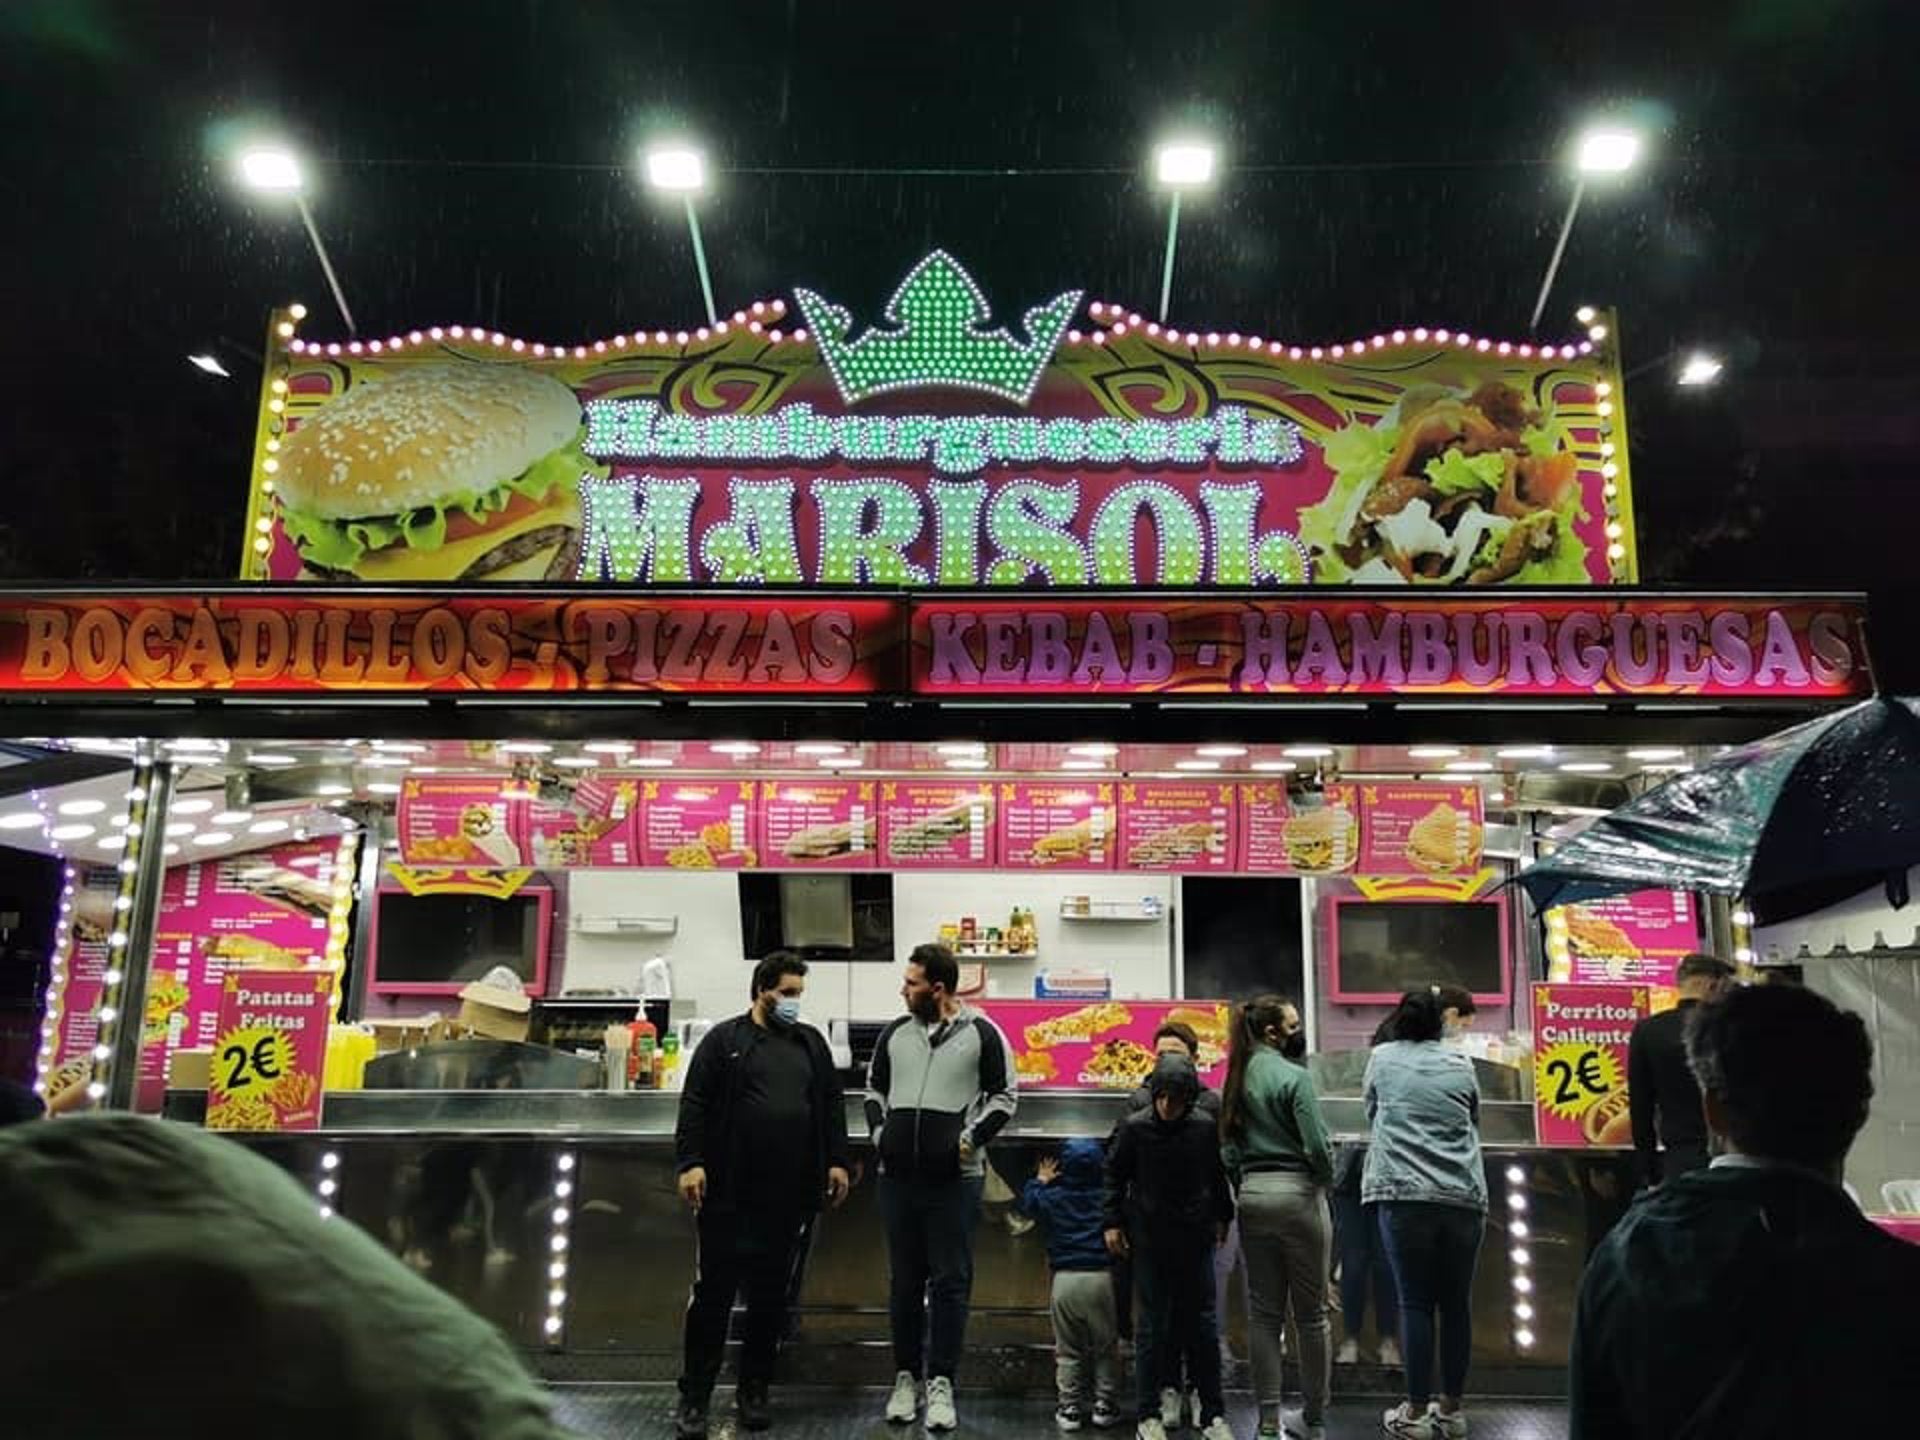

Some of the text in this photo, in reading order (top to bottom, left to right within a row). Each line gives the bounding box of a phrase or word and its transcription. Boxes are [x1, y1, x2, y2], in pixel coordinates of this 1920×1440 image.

[582, 399, 1303, 472] Hamburgueseria
[575, 473, 1312, 585] MARISOL
[20, 606, 511, 684] BOCADILLOS
[583, 606, 857, 685] PIZZAS
[929, 611, 1174, 685] KEBAB
[1239, 609, 1851, 687] HAMBURGUESAS
[236, 989, 315, 1006] Patatas
[240, 1012, 305, 1030] Fritas
[1546, 1002, 1637, 1020] Perritos
[1541, 1024, 1631, 1044] Caliente
[223, 1035, 281, 1089] 2€
[1546, 1050, 1609, 1105] 2€
